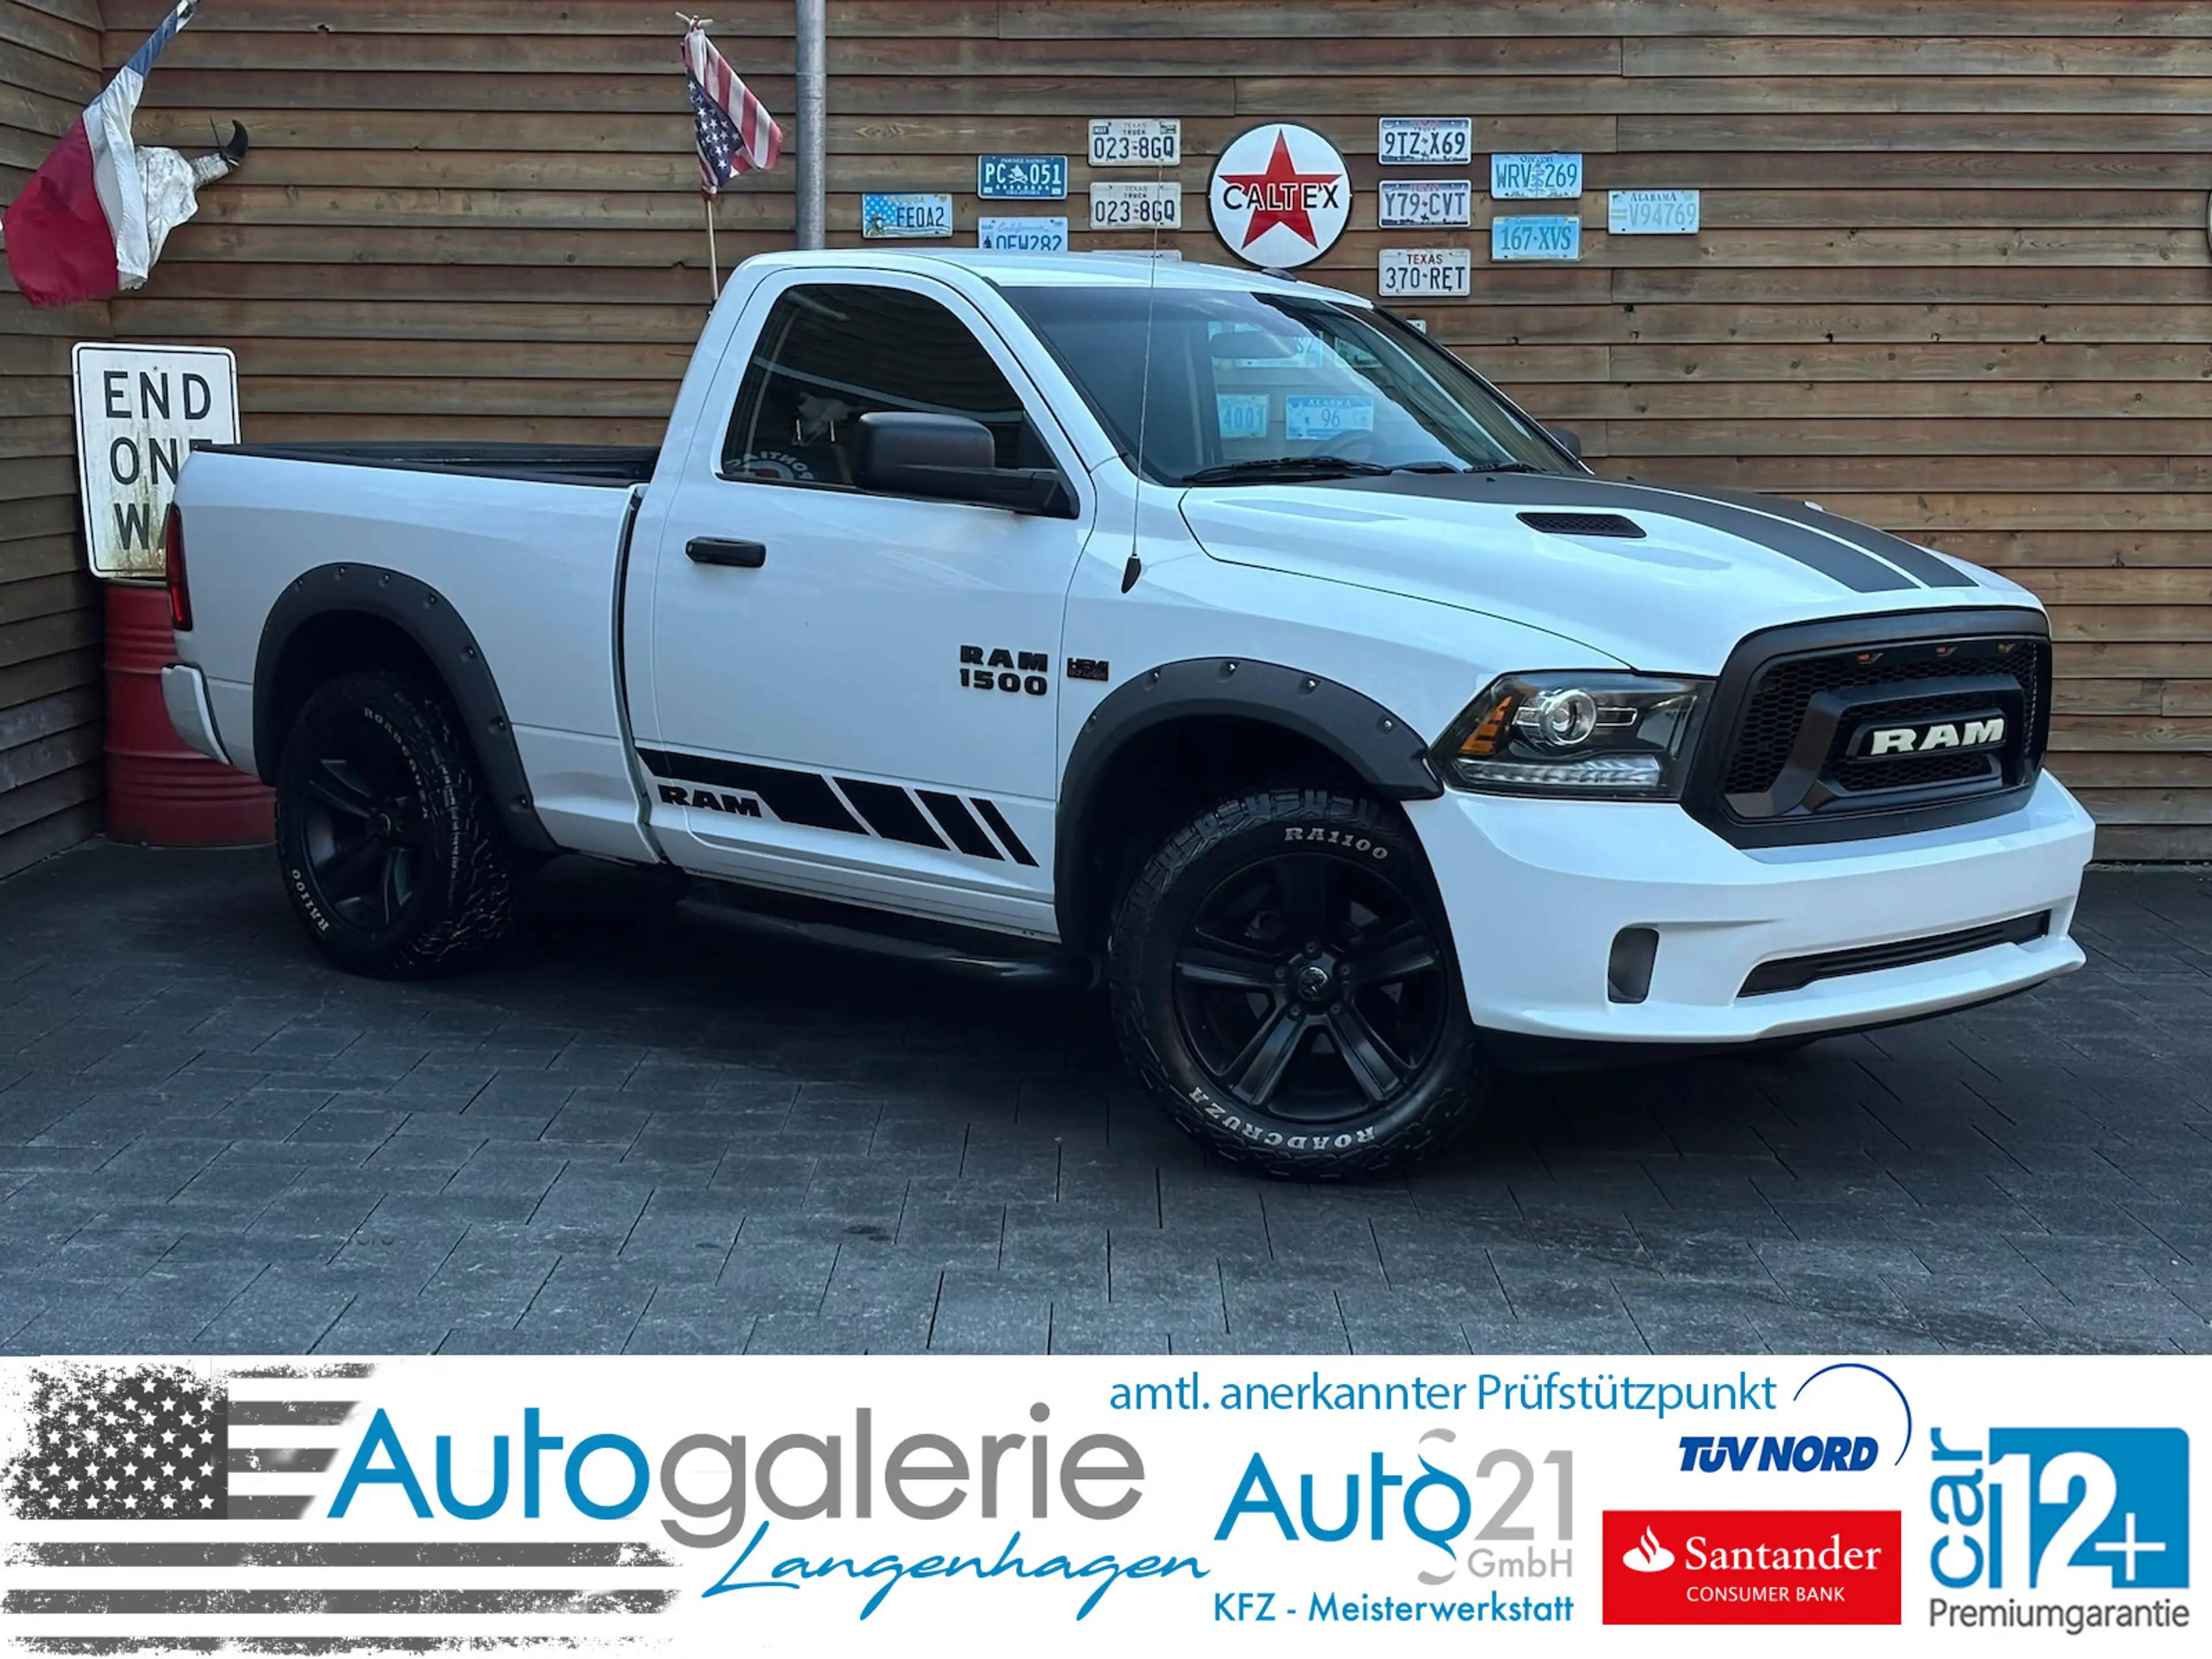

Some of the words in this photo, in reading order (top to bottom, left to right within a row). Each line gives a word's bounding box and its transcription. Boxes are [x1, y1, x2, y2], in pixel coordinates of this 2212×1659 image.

[1223, 184, 1339, 210] CALTEX
[1630, 192, 1677, 202] ALABAMA
[1407, 254, 1443, 264] TEXAS
[104, 370, 211, 420] END
[960, 644, 1048, 672] RAM
[959, 668, 1048, 696] 1500
[1870, 717, 2005, 756] RAM
[657, 783, 763, 818] RAM
[1284, 827, 1388, 861] RA1100
[1188, 1086, 1376, 1150] ROADCRUZA
